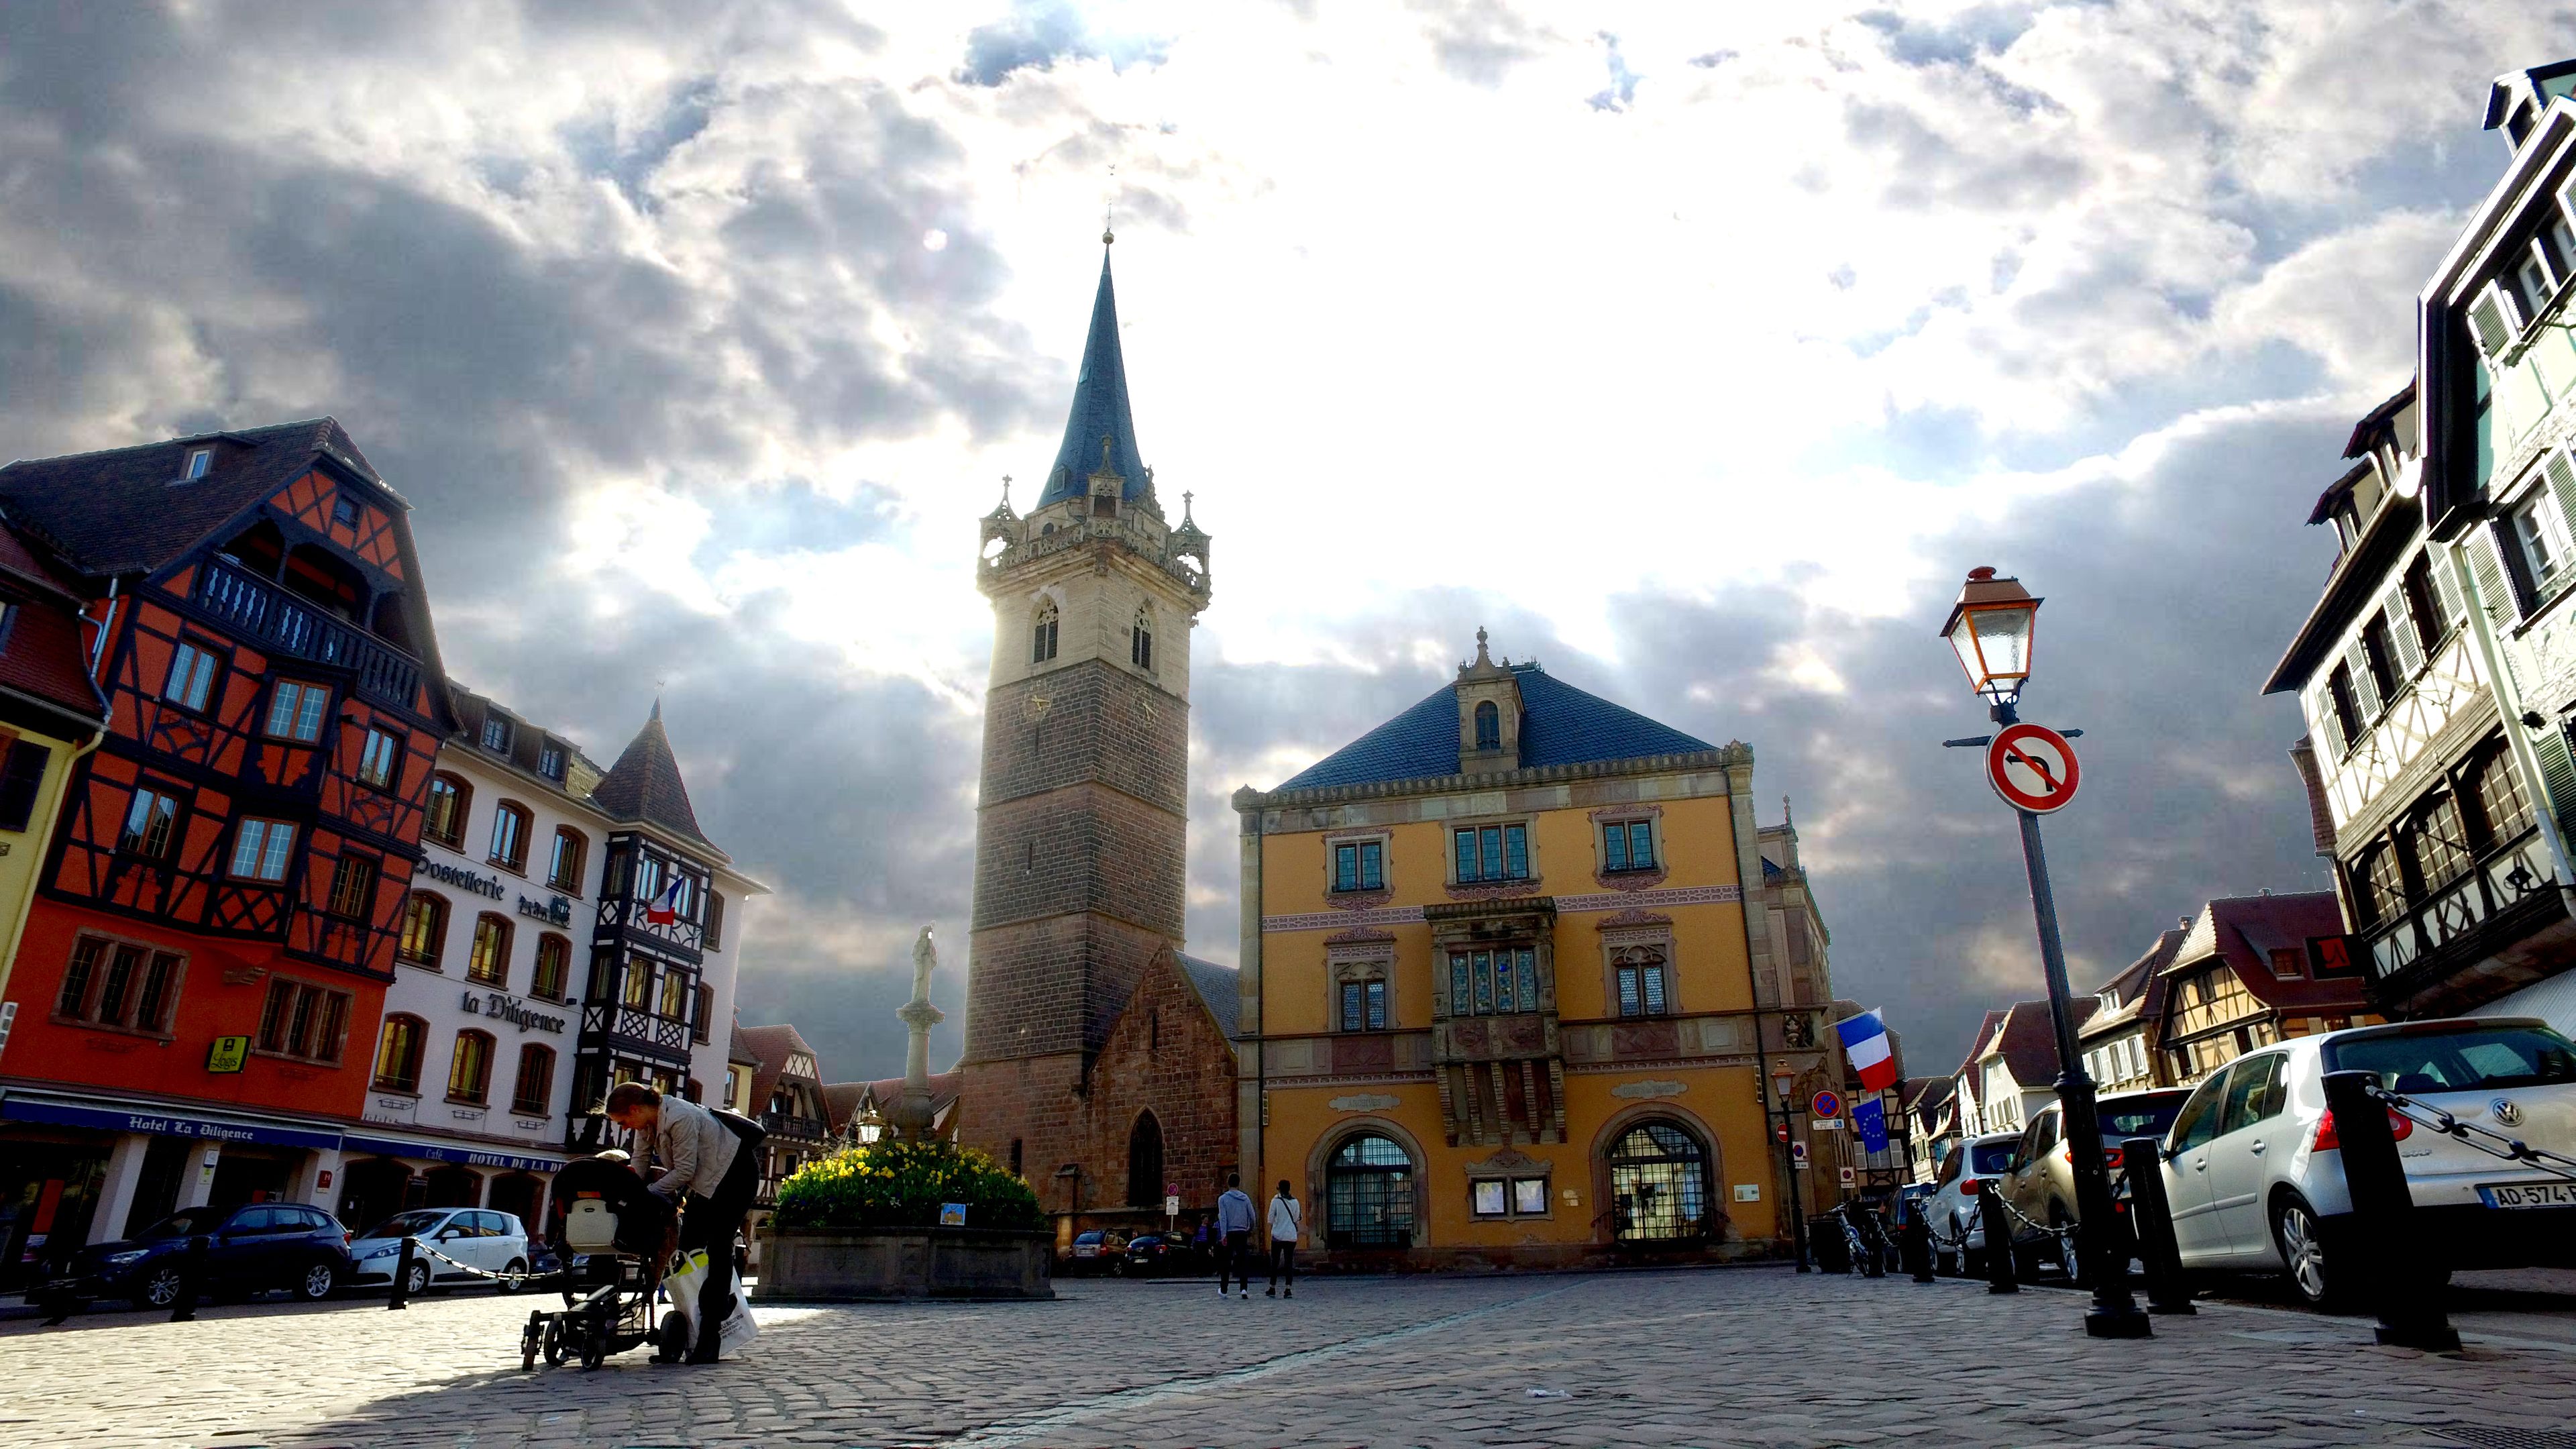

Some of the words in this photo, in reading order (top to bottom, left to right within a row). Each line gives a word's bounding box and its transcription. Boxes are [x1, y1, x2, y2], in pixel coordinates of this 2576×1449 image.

[486, 994, 565, 1034] Diligence
[130, 1116, 168, 1132] Hotel
[174, 1121, 192, 1134] La
[199, 1124, 254, 1140] Diligence
[469, 1152, 506, 1167] HOTEL
[511, 1158, 527, 1170] DE
[531, 1160, 545, 1171] LA
